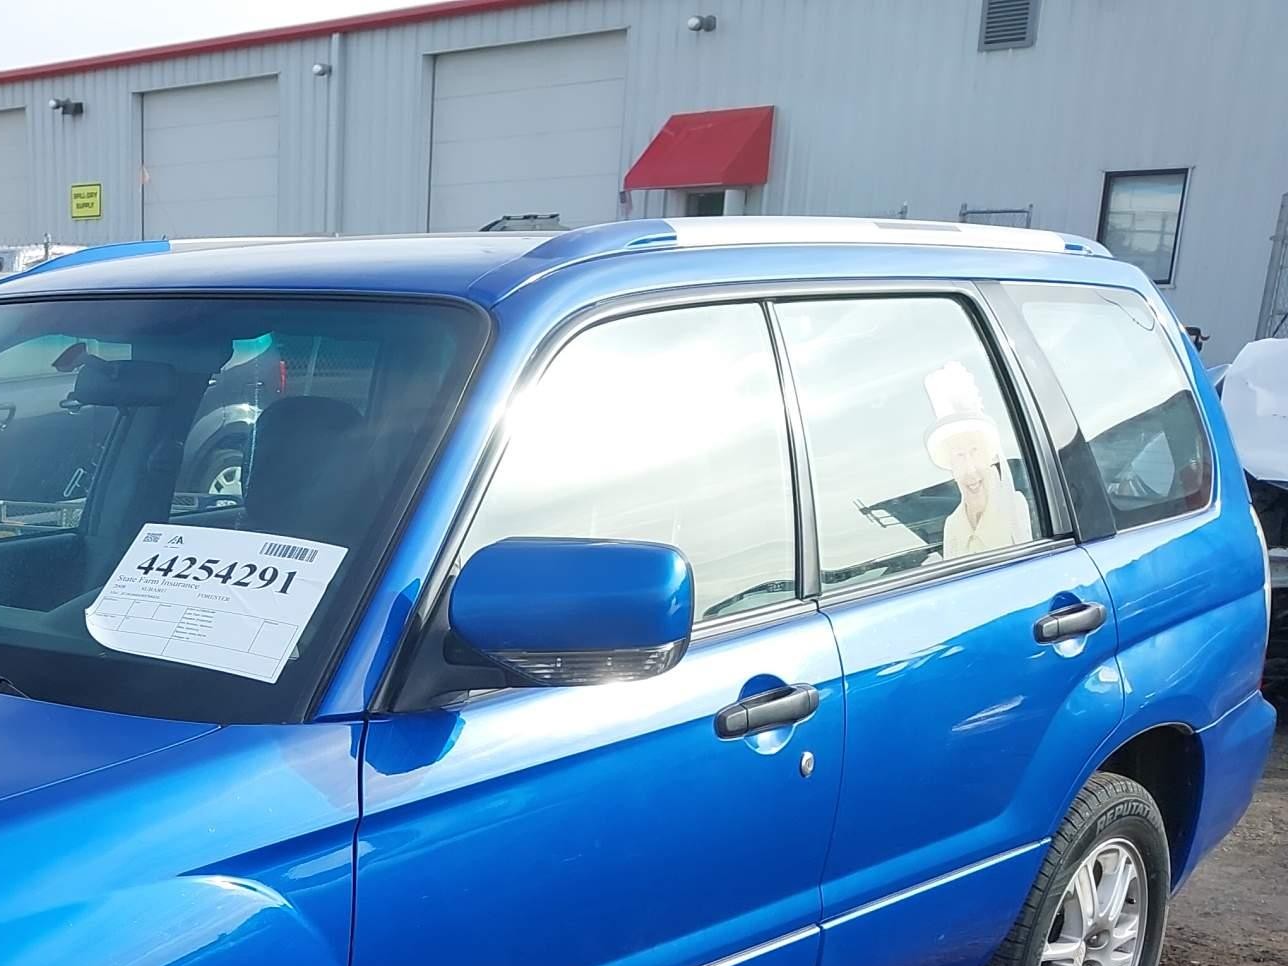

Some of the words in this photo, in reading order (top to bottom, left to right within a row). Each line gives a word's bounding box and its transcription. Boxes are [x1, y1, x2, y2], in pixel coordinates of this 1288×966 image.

[117, 574, 137, 583] State
[138, 577, 159, 585] Farm
[160, 579, 200, 590] Insurance
[136, 553, 298, 595] 44254291
[197, 593, 230, 602] FORESTER
